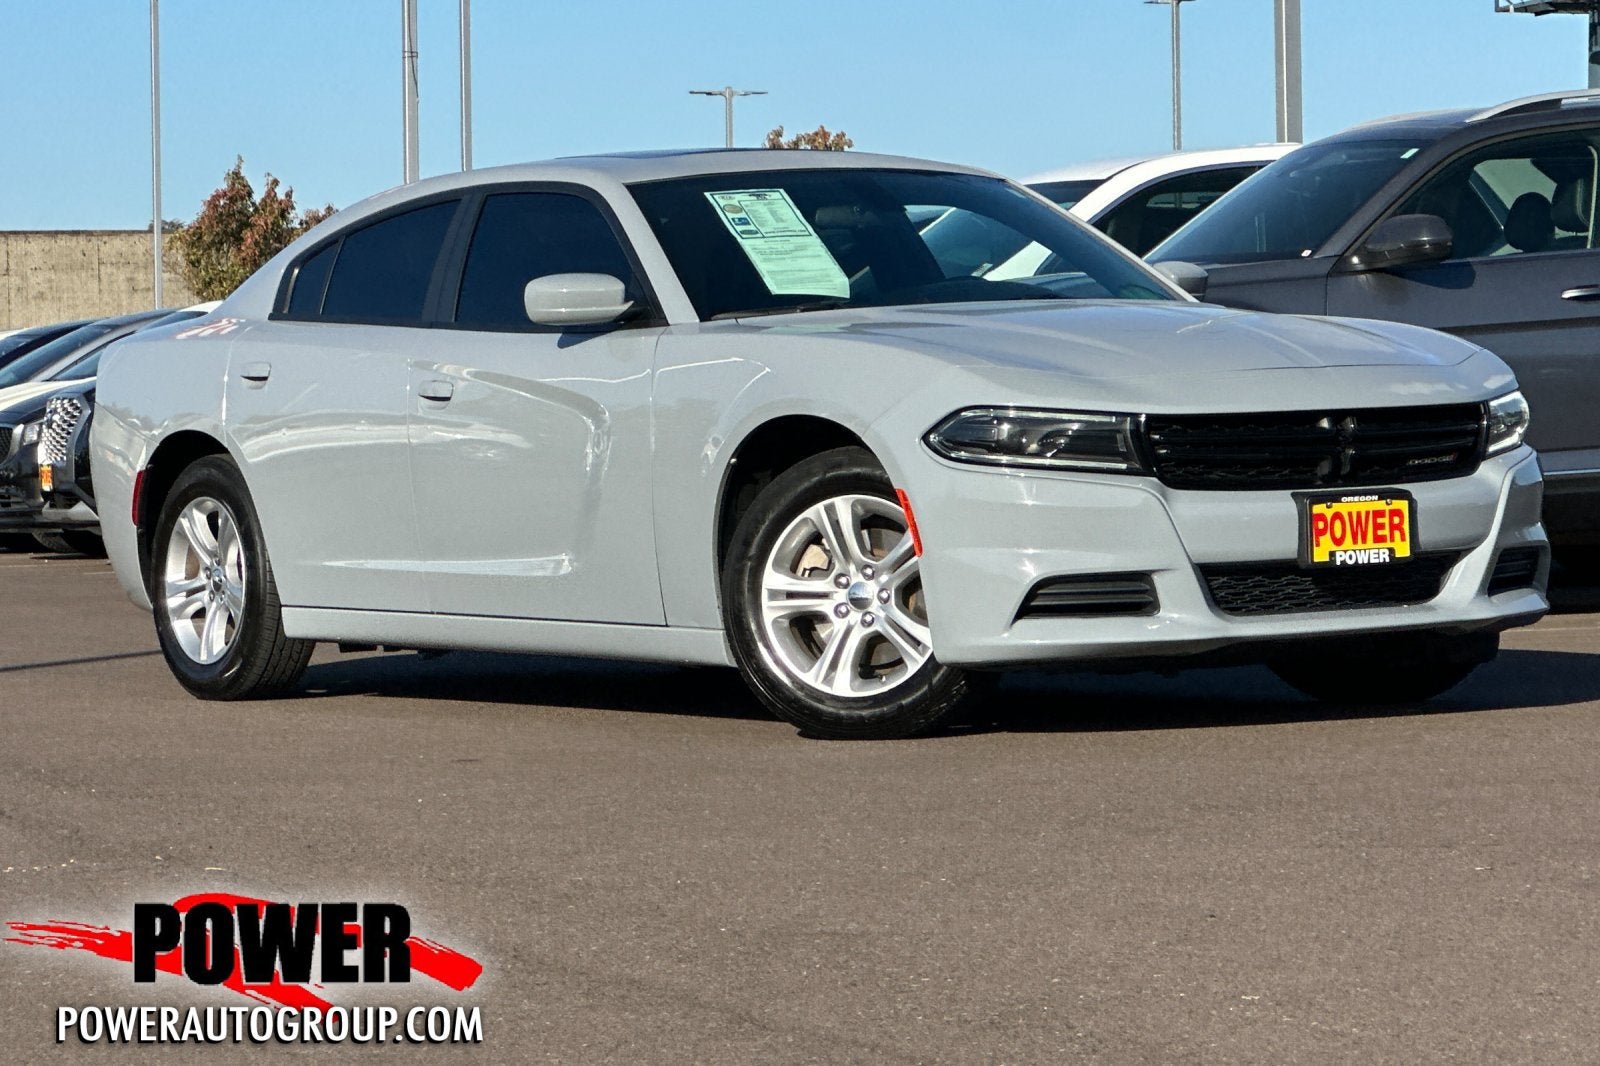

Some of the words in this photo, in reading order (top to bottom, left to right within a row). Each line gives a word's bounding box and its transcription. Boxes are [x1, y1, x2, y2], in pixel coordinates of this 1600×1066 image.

[1408, 455, 1454, 465] DODGE
[1312, 508, 1406, 547] POWER
[1335, 549, 1390, 565] POWER
